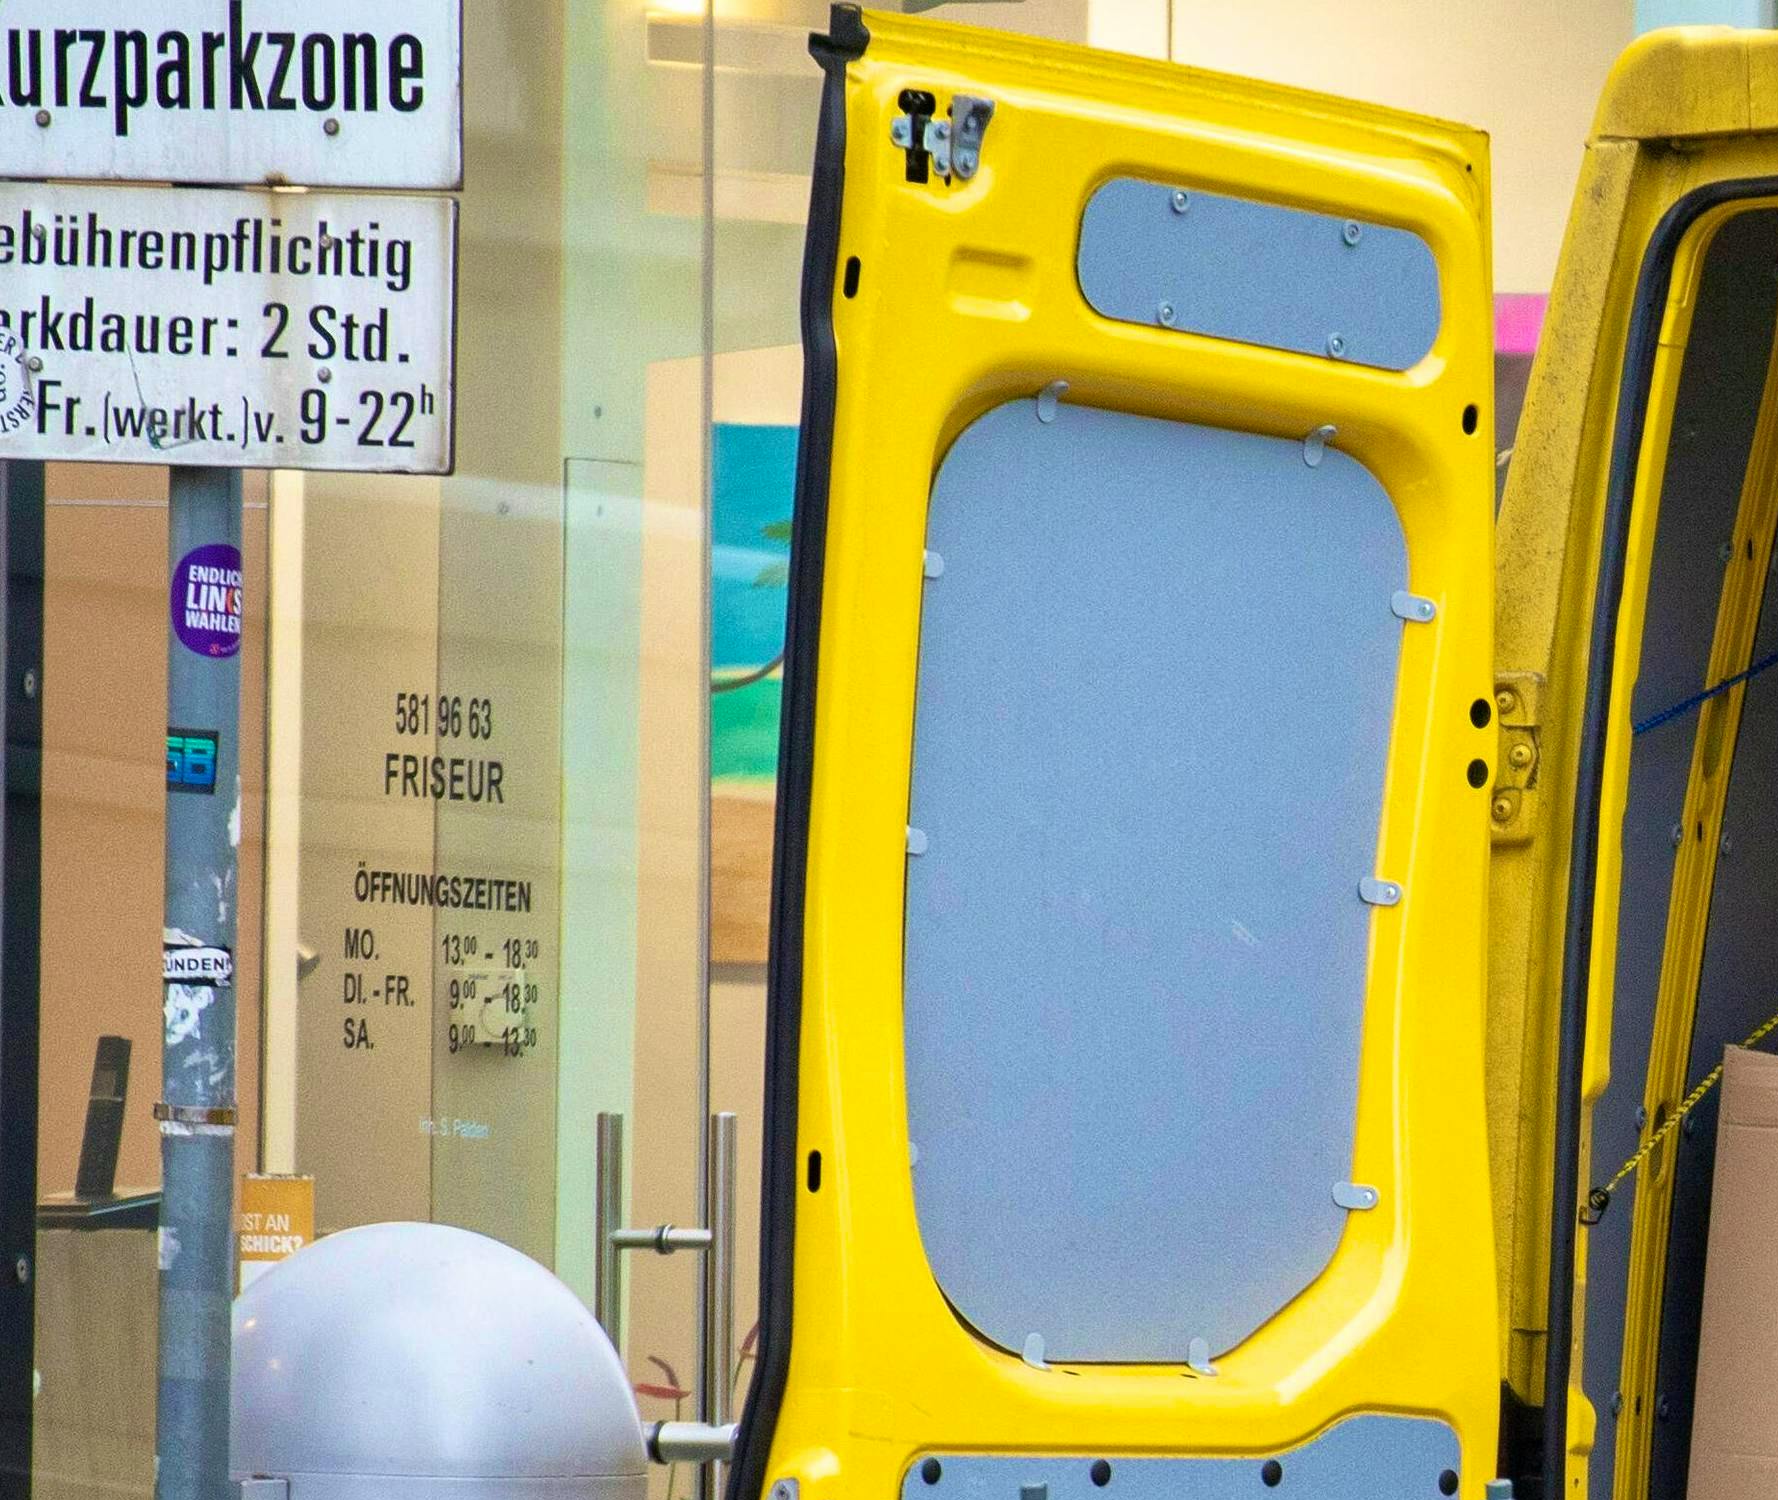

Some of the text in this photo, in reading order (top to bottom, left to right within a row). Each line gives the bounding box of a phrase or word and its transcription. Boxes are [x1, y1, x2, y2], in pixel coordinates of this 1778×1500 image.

[0, 0, 424, 137] urzparkzone
[261, 302, 289, 359] 2
[307, 305, 410, 363] Std.
[396, 692, 492, 740] 581 96 63
[385, 752, 504, 804] FRISEUR
[354, 860, 532, 913] ÖFFNUNGSZEITEN
[344, 928, 379, 960] MO.
[343, 1017, 374, 1050] SA.
